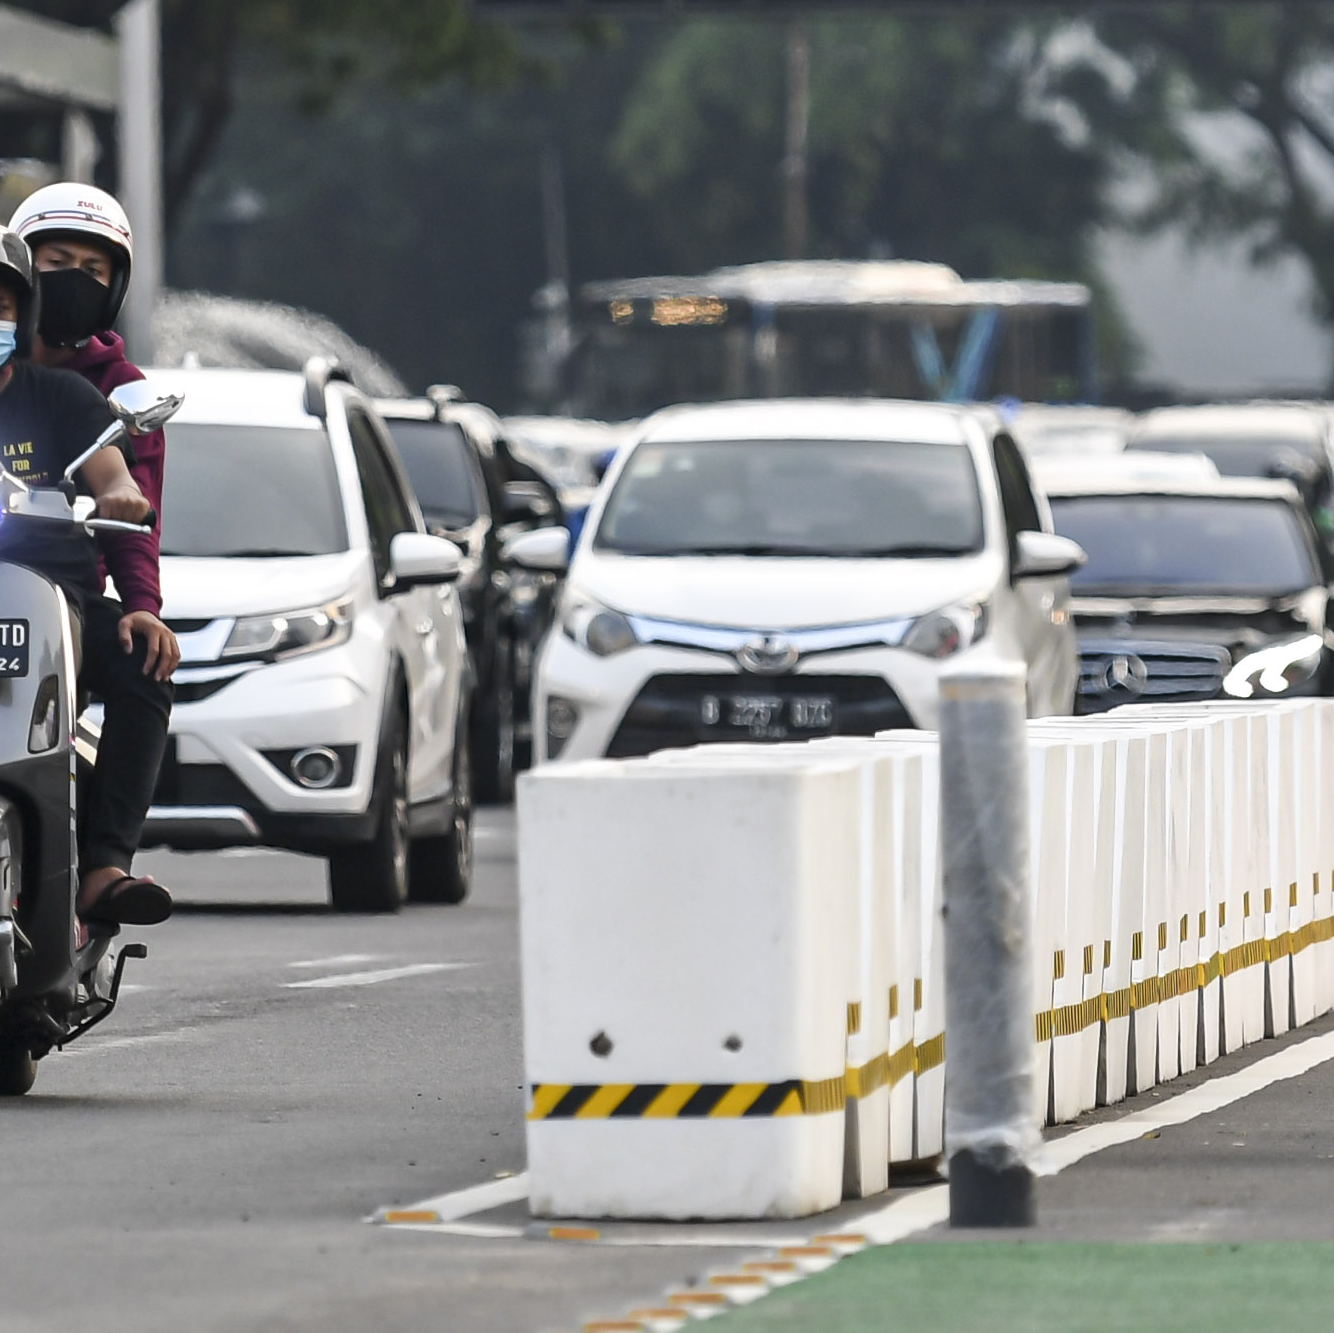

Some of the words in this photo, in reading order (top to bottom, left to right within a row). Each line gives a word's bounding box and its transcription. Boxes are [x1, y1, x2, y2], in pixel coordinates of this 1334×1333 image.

[3, 444, 16, 457] LA
[17, 441, 34, 455] VIE
[12, 459, 30, 472] FOR
